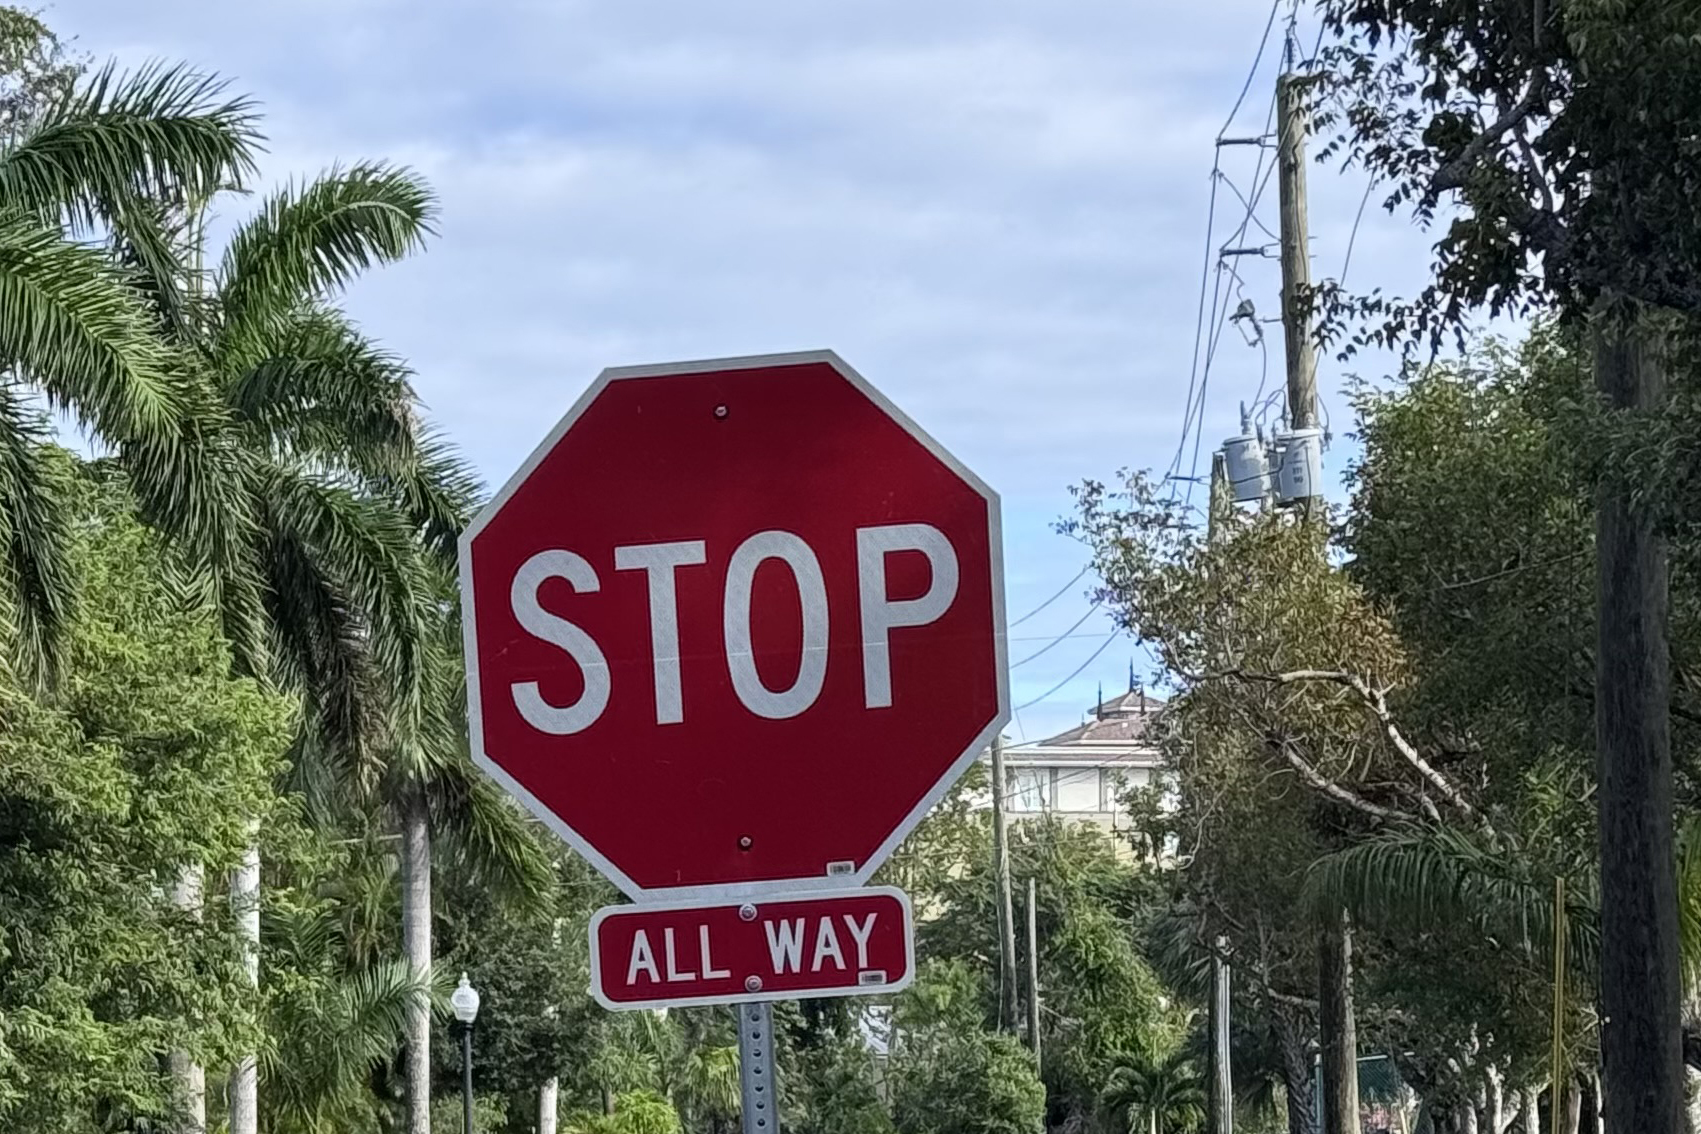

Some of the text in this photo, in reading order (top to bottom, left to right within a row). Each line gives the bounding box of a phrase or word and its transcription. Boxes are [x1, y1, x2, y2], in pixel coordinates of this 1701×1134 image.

[510, 523, 959, 735] STOP
[626, 912, 877, 985] ALL WAY
